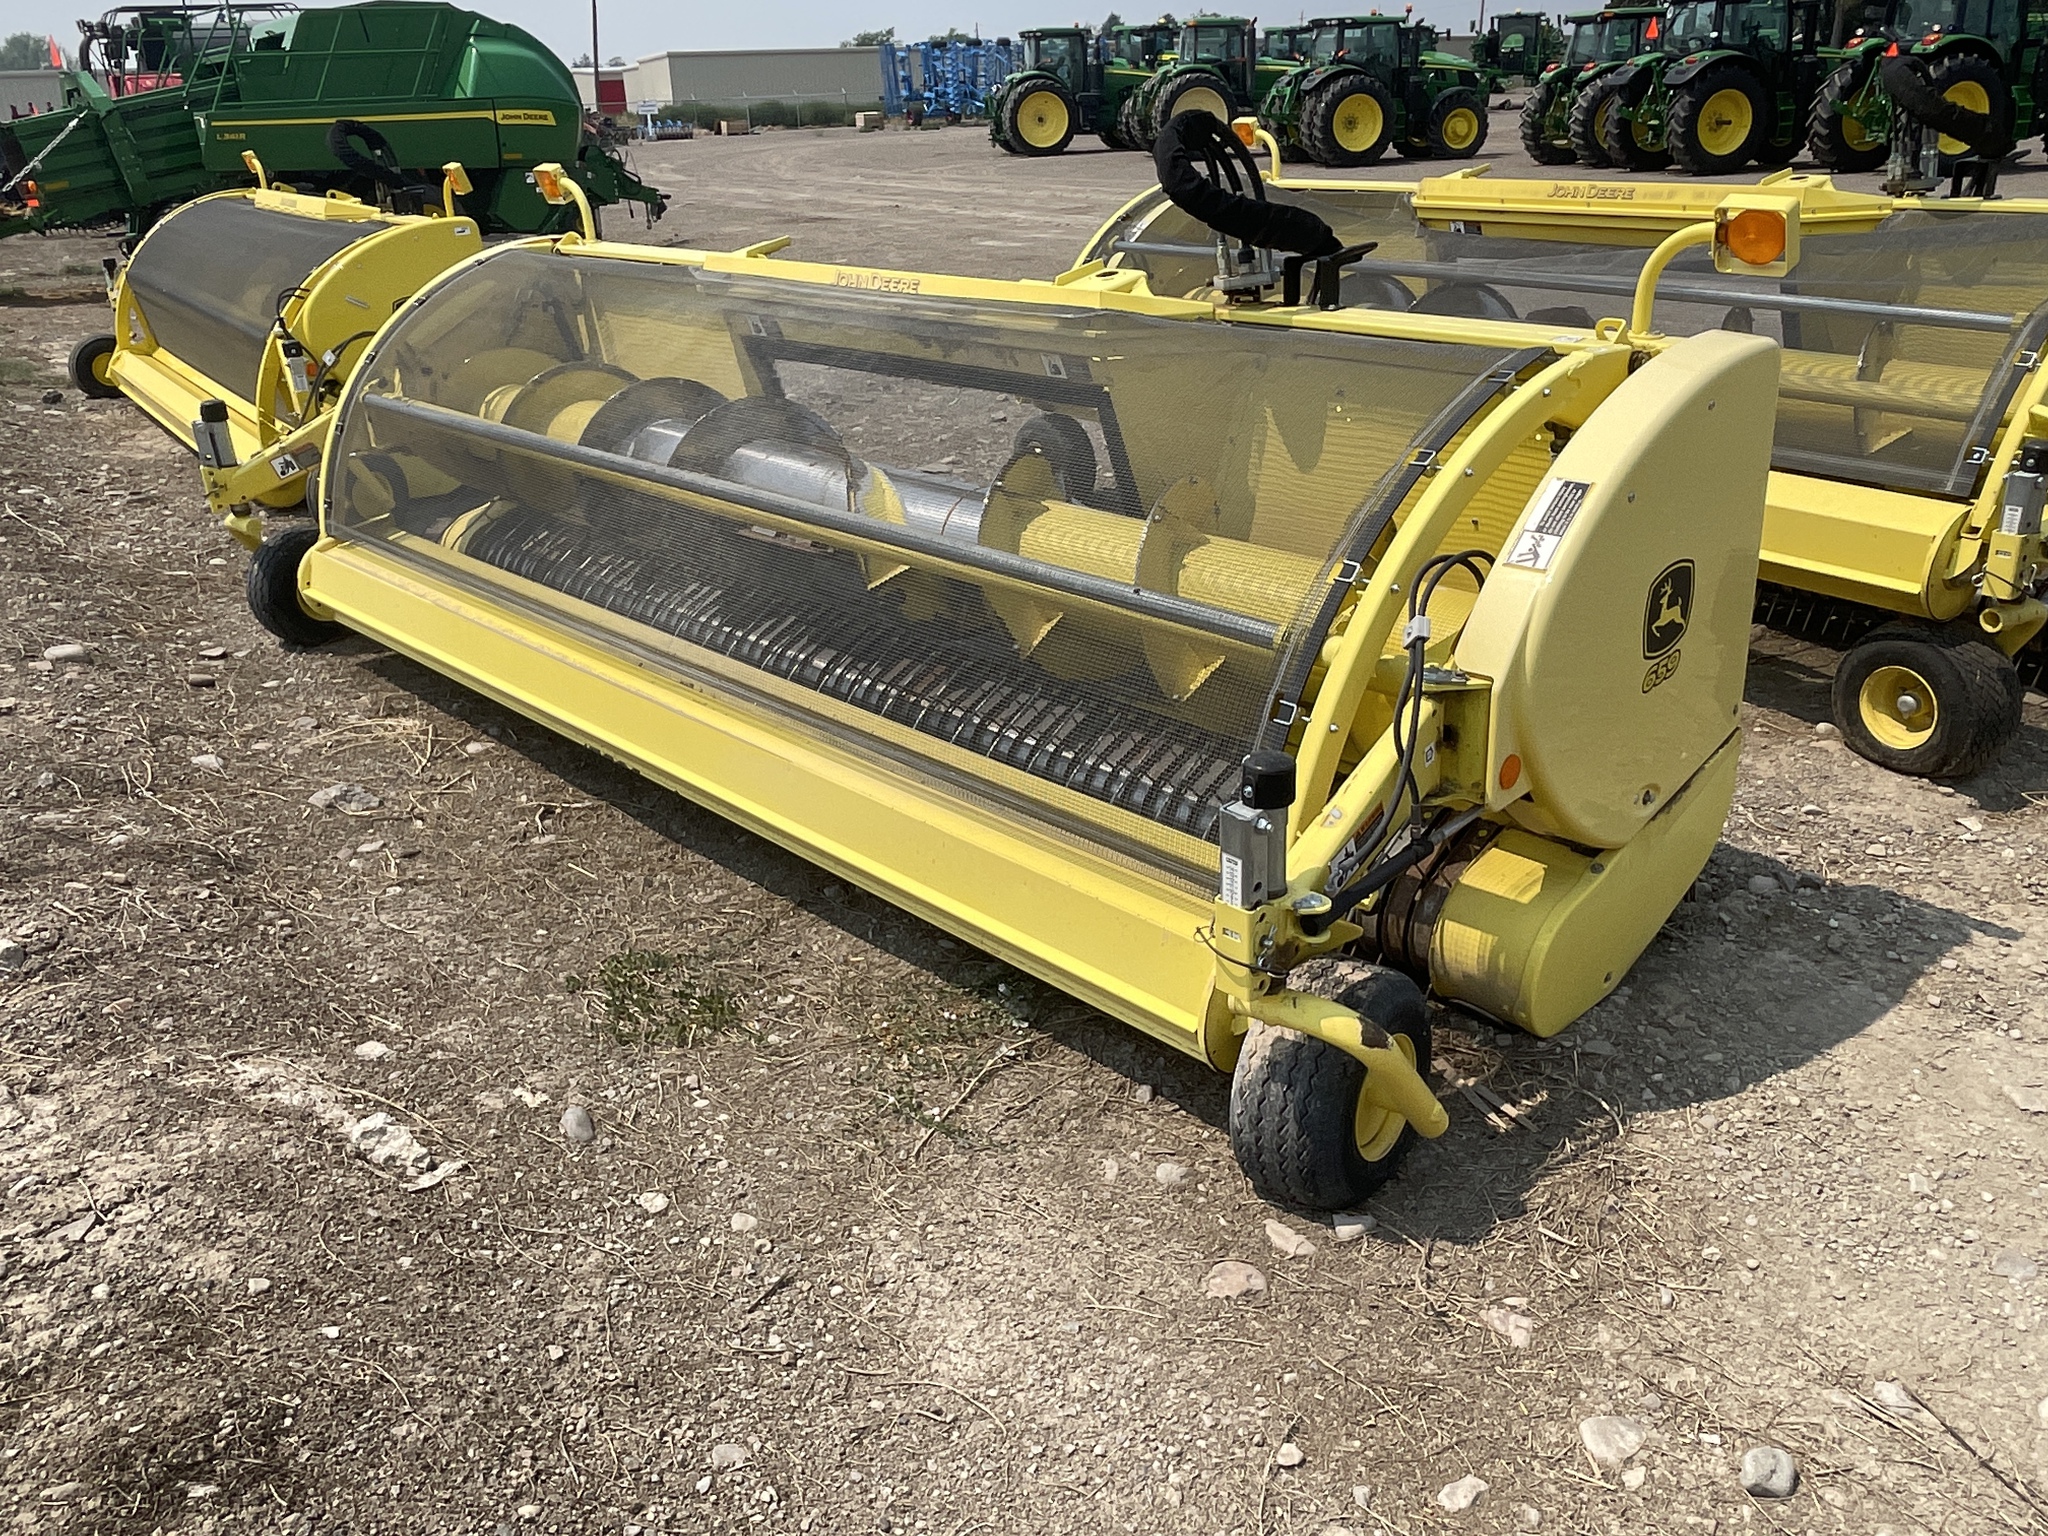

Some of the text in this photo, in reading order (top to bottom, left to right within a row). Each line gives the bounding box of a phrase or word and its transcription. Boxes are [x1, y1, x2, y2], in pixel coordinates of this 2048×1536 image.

[1547, 183, 1636, 200] JOHN DEERE
[834, 270, 920, 294] JOHN DEERE
[1642, 649, 1681, 693] 659
